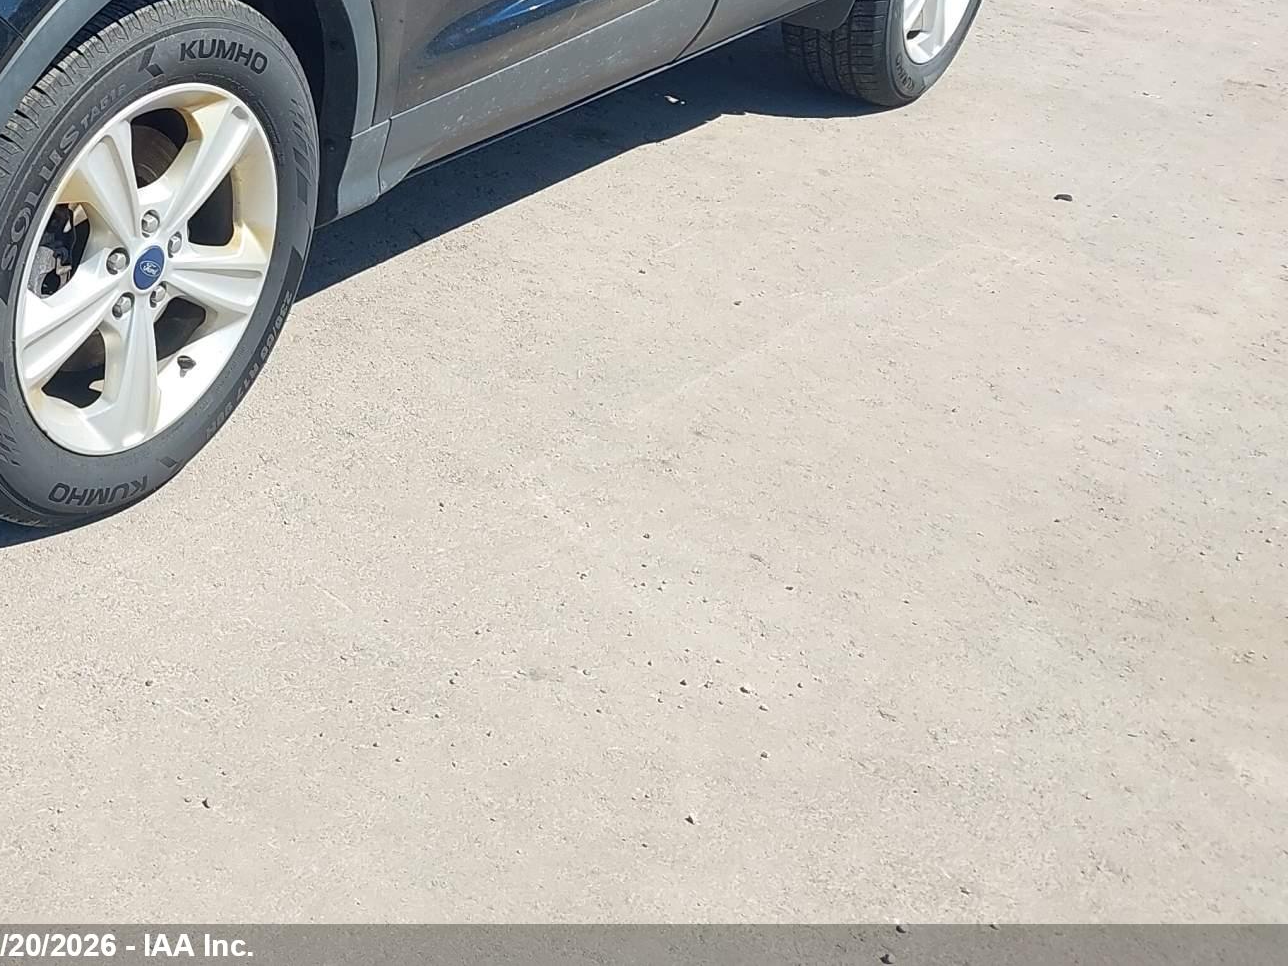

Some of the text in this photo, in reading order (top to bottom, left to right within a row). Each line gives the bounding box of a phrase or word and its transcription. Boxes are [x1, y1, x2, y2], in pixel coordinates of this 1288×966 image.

[179, 38, 268, 75] KUMHO
[0, 124, 80, 272] SOLUS
[142, 261, 160, 275] Ford
[48, 475, 148, 507] KUMHO
